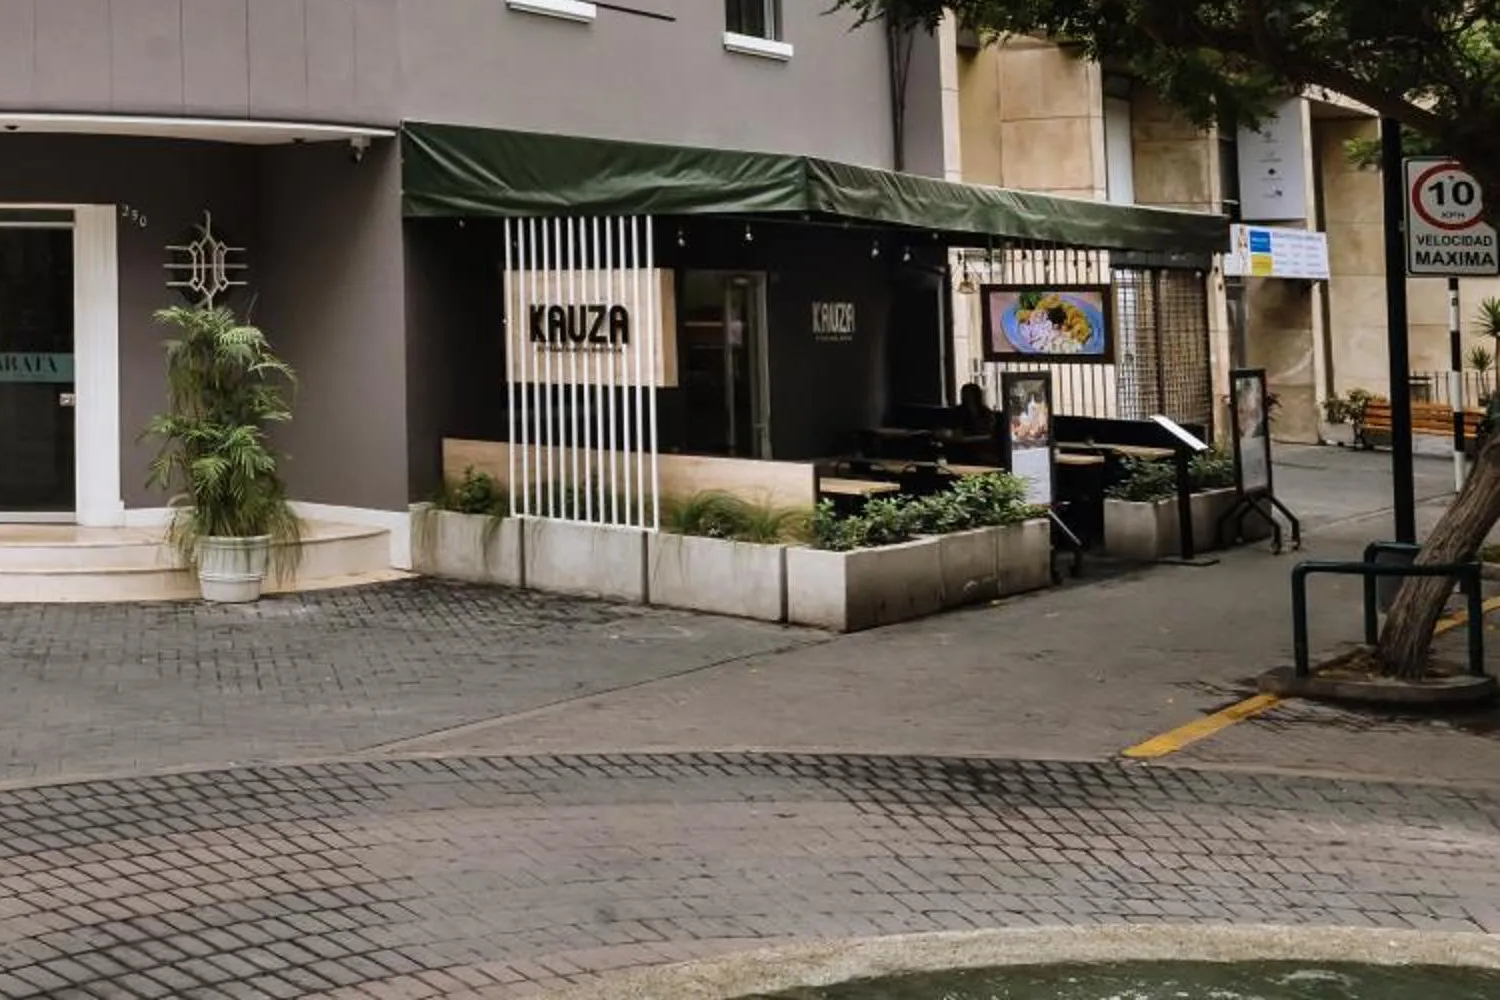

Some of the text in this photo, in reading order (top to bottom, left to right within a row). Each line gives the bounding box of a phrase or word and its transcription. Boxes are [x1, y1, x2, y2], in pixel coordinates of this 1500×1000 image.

[1428, 181, 1474, 206] 10
[1416, 234, 1493, 247] VELOCIDAD
[1415, 251, 1495, 267] MAXIMA
[529, 303, 630, 344] KAUZA
[812, 301, 856, 333] KAUZA
